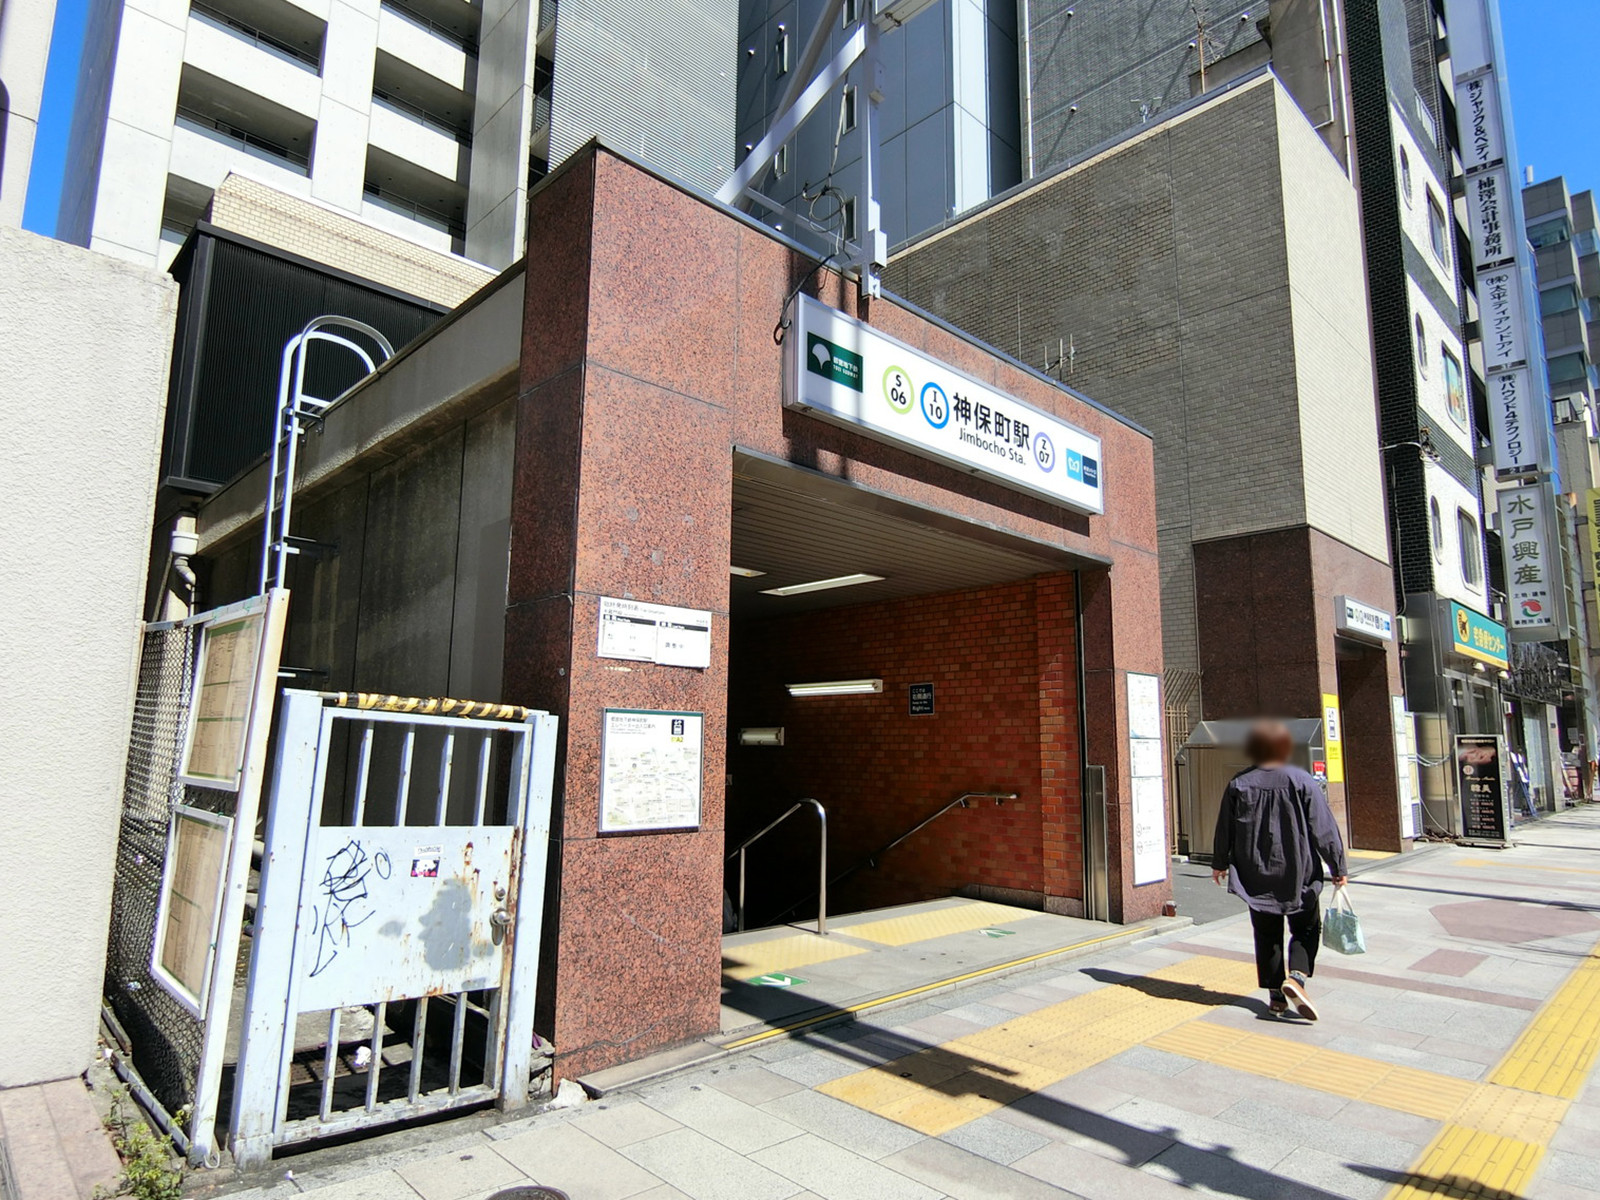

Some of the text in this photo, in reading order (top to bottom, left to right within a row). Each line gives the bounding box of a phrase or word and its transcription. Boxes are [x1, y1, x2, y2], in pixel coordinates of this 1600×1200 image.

[895, 374, 902, 388] S
[890, 387, 907, 405] 06
[932, 390, 938, 403] I
[929, 403, 943, 420] 10
[953, 392, 1031, 451] 神保町駅
[959, 427, 1026, 466] Jimbocho Sta.
[1041, 438, 1048, 451] Z
[1038, 450, 1050, 464] 07
[1507, 494, 1542, 585] 水戸興産
[1473, 626, 1505, 653] 宅急便センター
